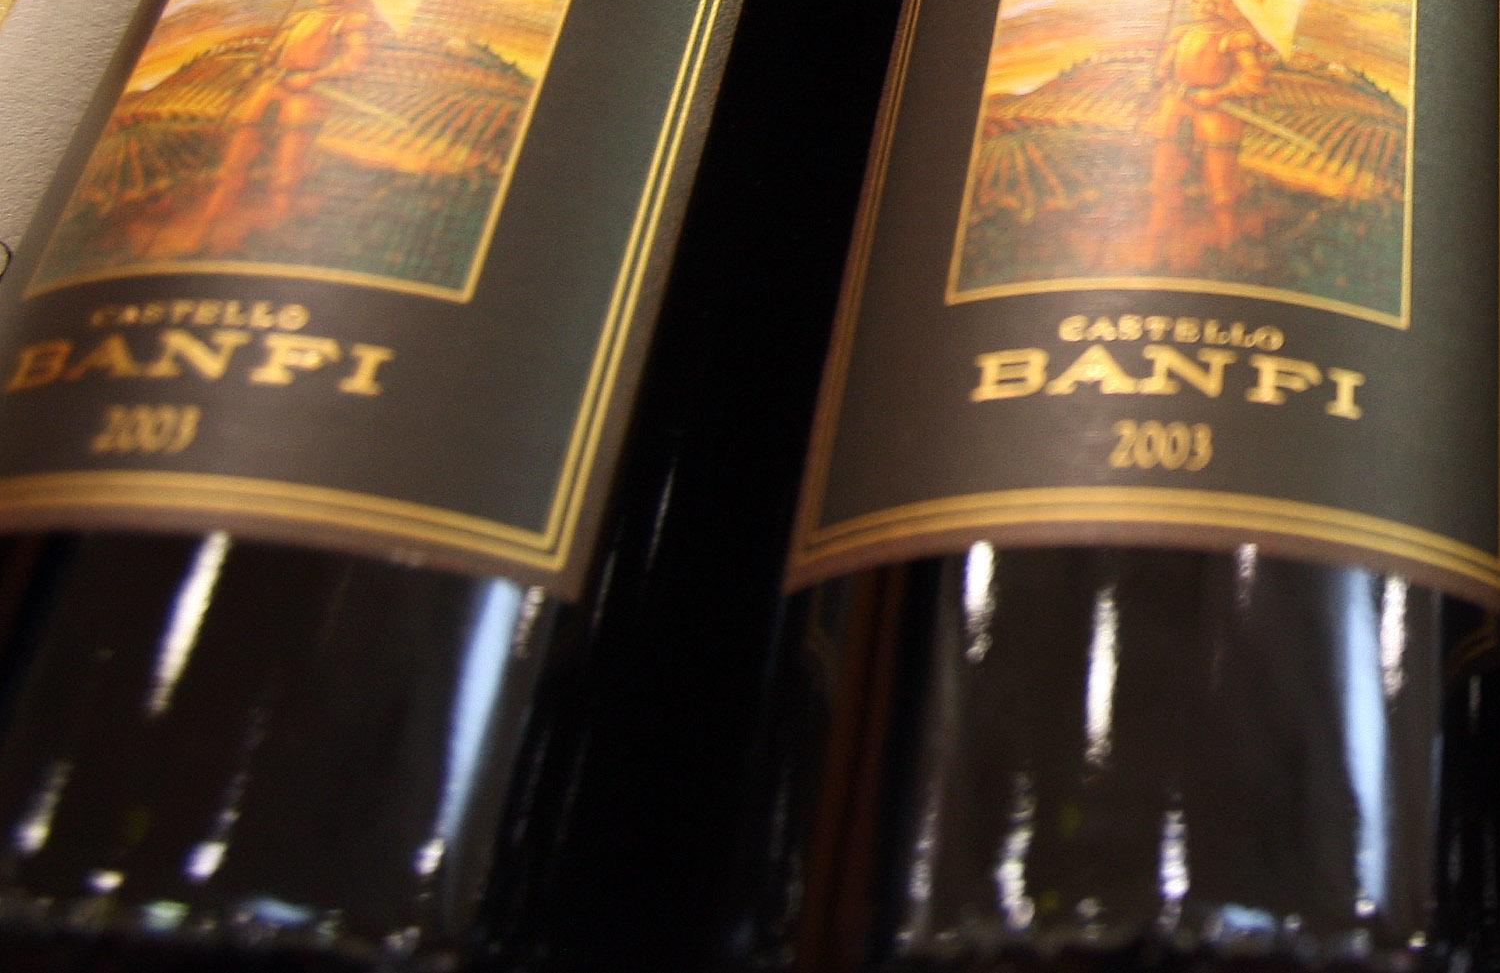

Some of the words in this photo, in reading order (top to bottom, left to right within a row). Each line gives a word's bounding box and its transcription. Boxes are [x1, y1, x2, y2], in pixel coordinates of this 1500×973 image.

[1058, 314, 1285, 351] CASTELLO
[970, 343, 1367, 420] BANFI
[1109, 419, 1213, 471] 2003
